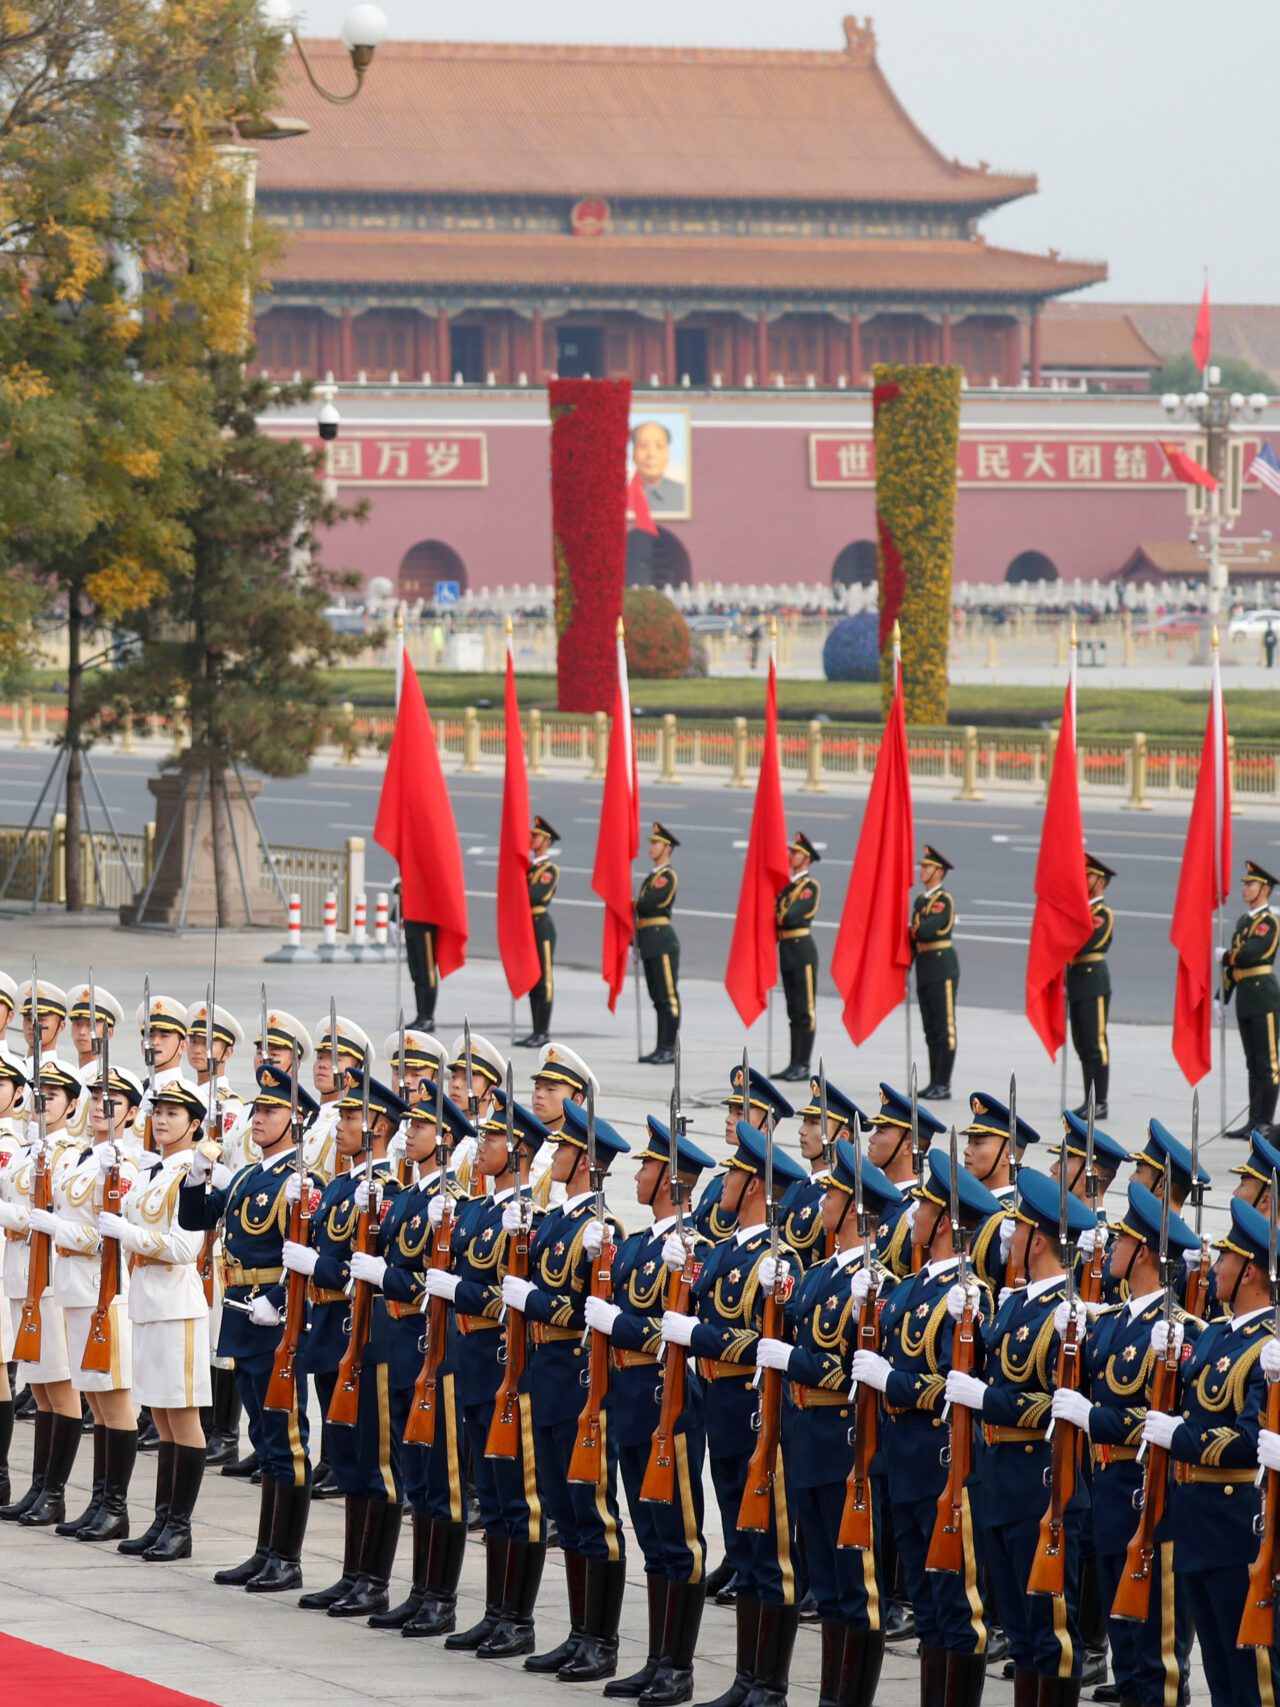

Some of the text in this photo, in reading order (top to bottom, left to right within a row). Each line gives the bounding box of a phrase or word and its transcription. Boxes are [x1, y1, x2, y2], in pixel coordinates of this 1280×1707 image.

[302, 441, 460, 477] 国万岁
[837, 443, 1228, 479] 世民大团结
